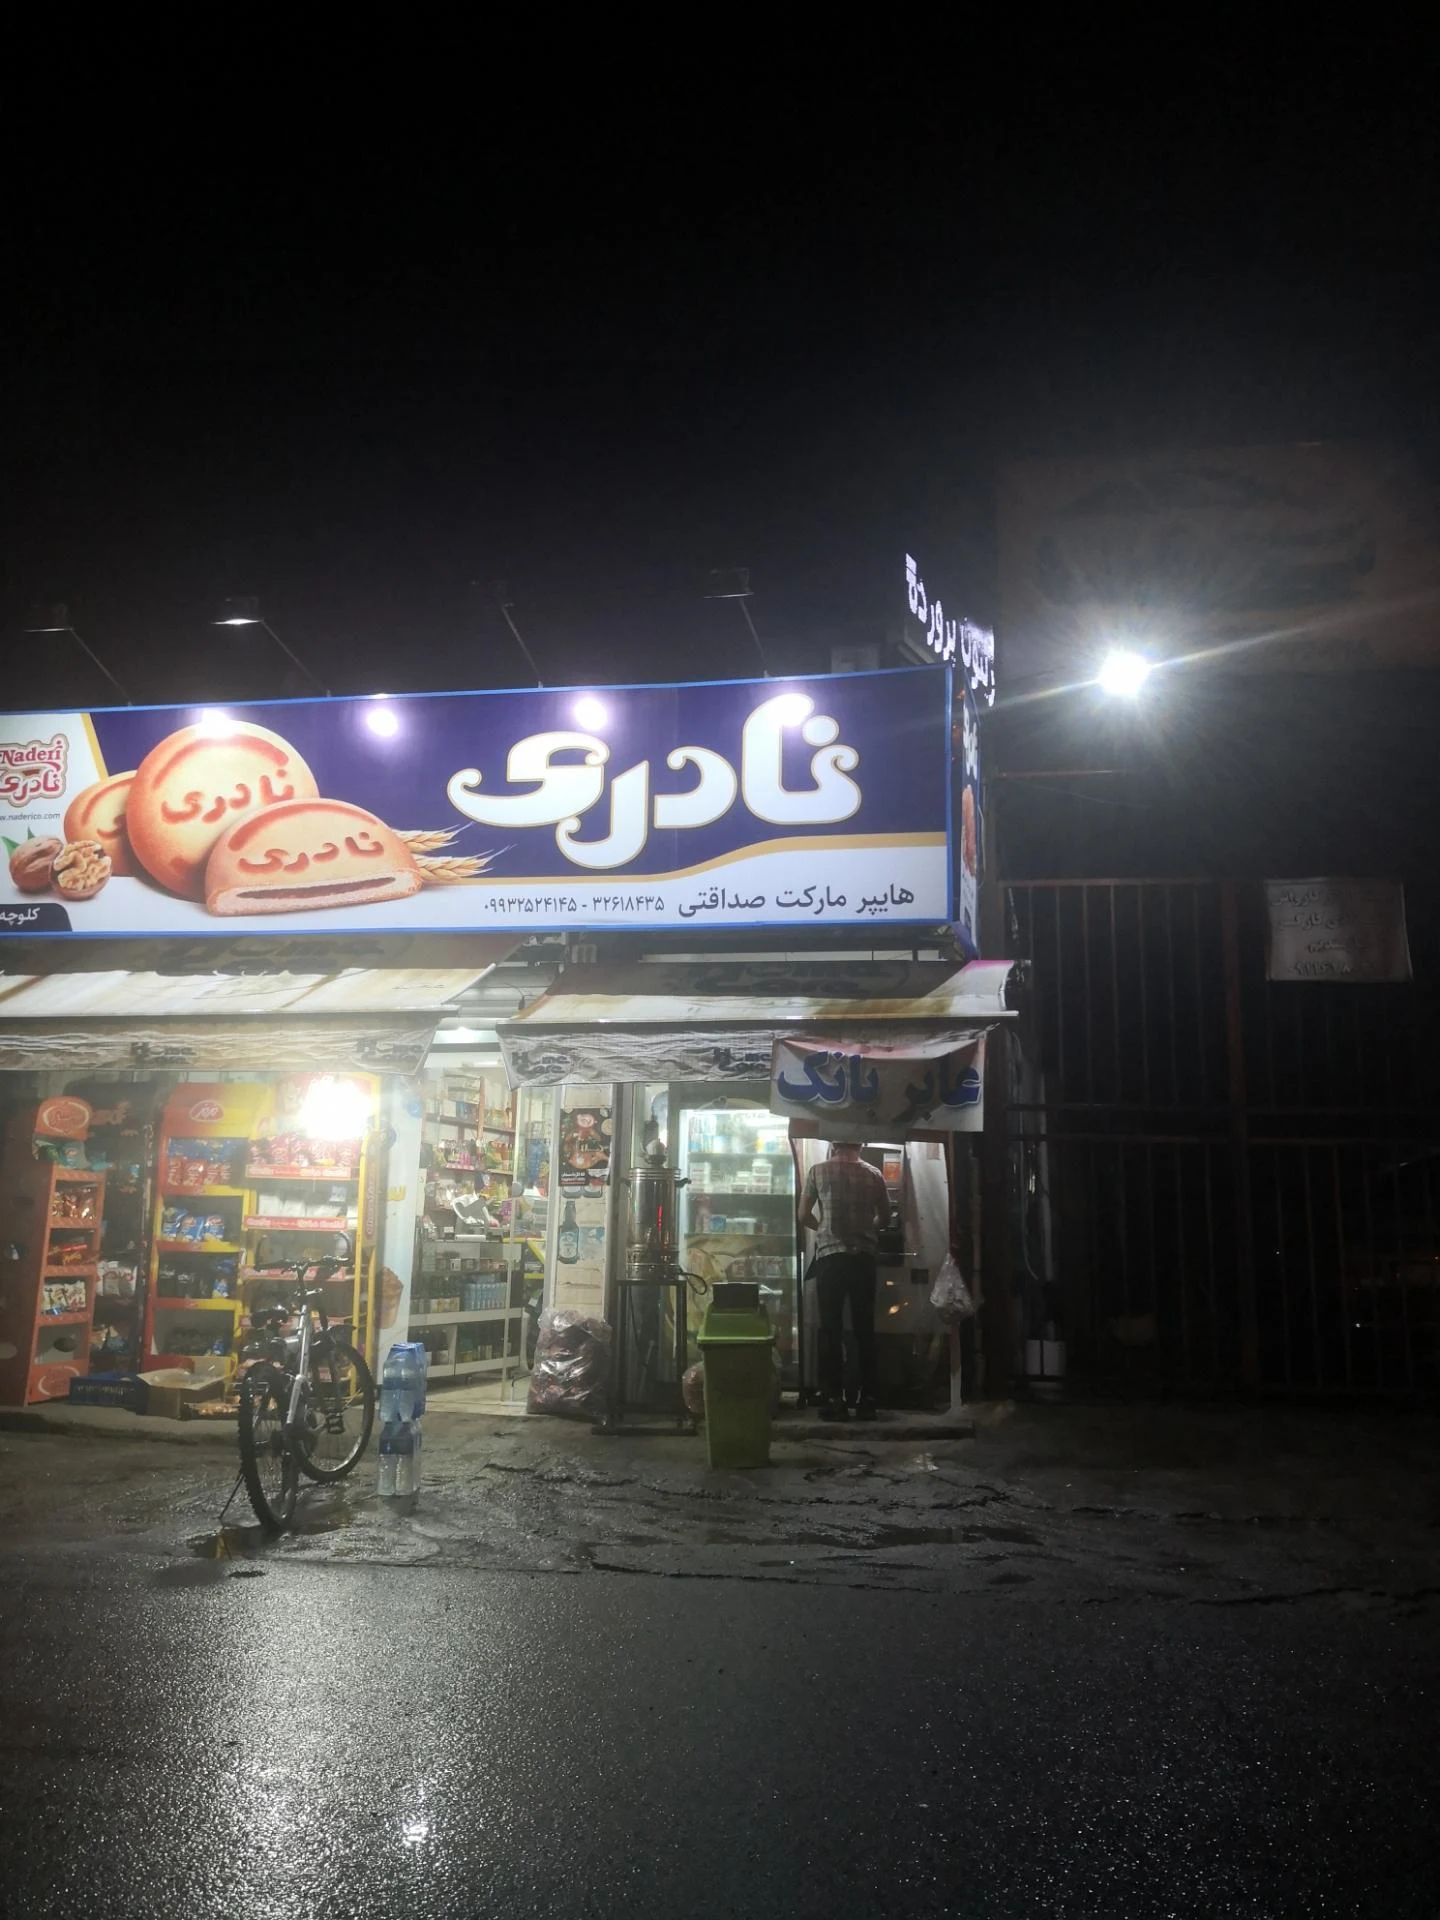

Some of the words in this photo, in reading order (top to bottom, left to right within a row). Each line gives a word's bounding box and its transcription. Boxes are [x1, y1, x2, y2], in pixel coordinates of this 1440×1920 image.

[0, 739, 63, 769] Naderi
[160, 768, 295, 825] نادری
[446, 692, 862, 870] نادری
[237, 831, 386, 875] نادری
[678, 886, 766, 918] صداقتی
[775, 885, 847, 915] مارکت
[856, 883, 915, 916] هایپر
[776, 1050, 880, 1120] بانک
[890, 1052, 982, 1122] عابر
